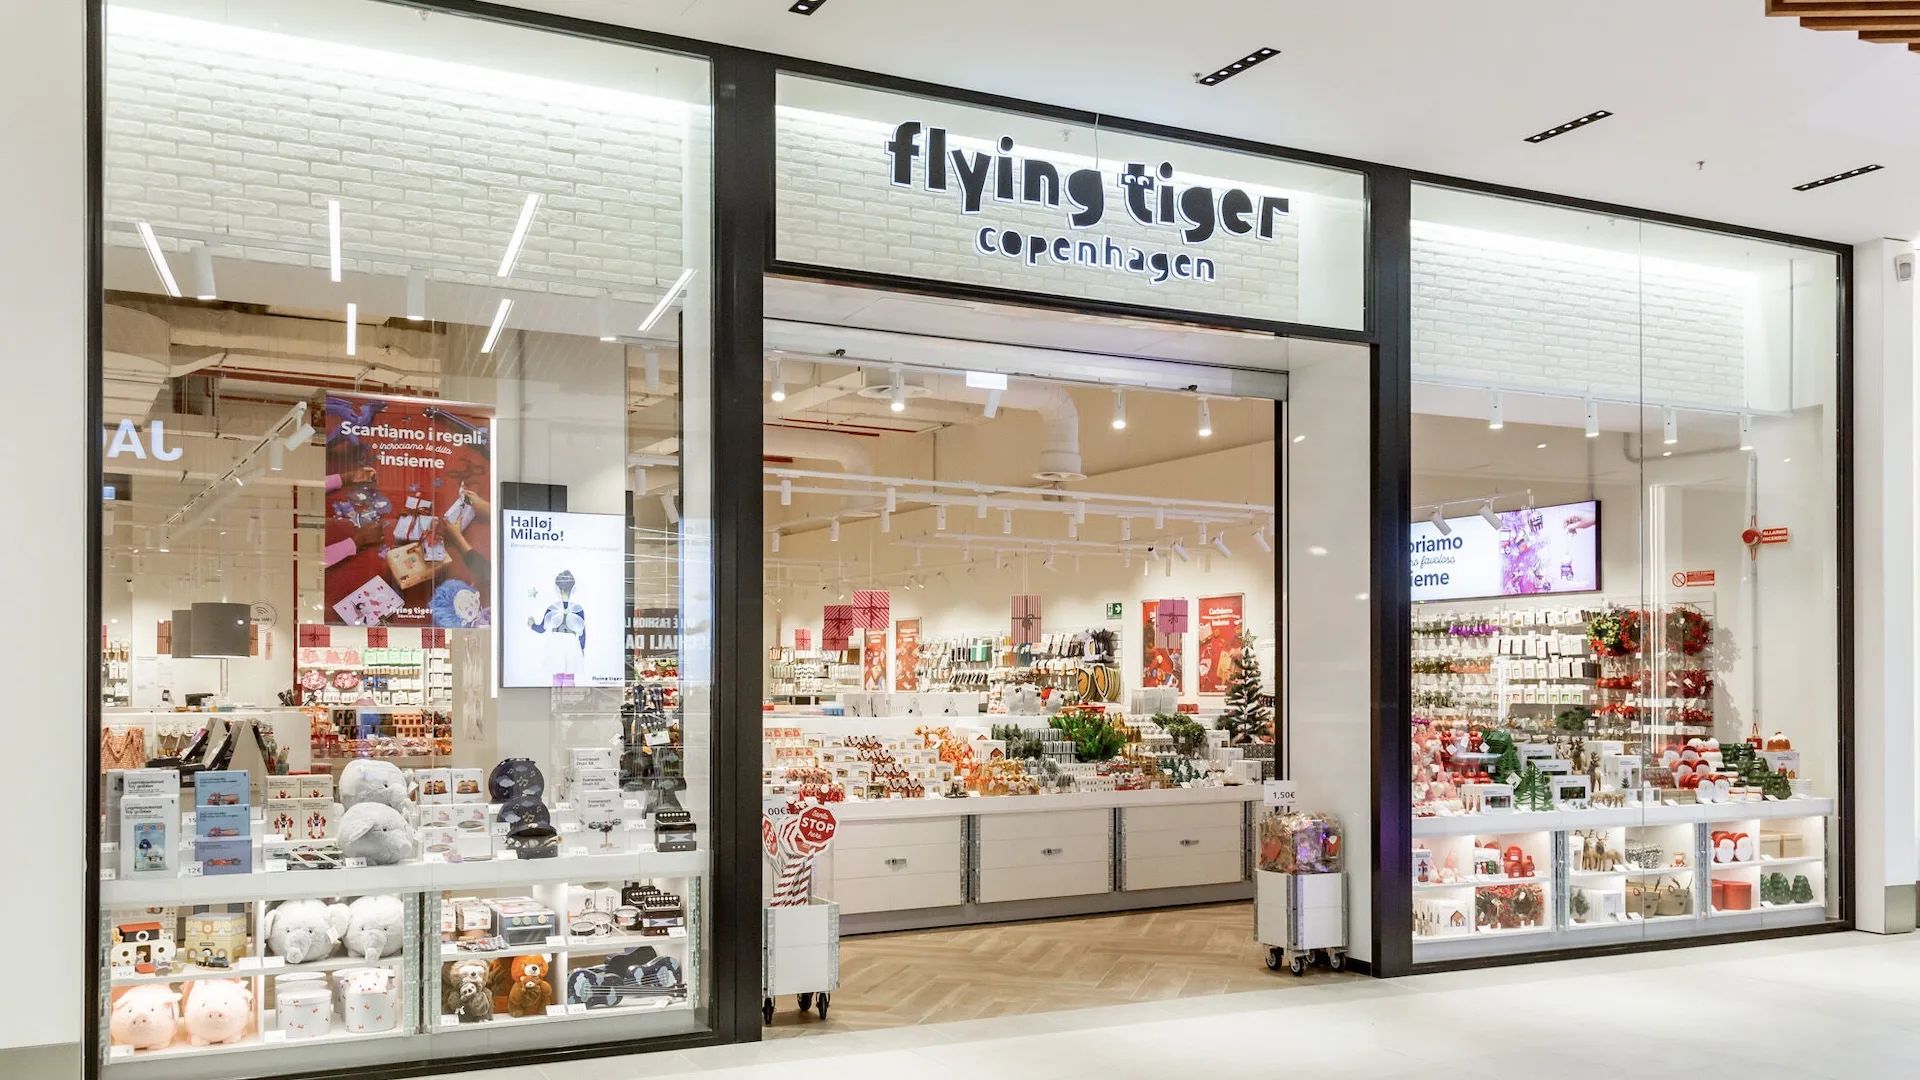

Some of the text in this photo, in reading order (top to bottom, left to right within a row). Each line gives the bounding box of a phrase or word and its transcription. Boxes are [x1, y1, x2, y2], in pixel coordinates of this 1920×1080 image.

[884, 120, 1290, 245] flying tiger
[975, 226, 1217, 285] copenhagen
[340, 420, 482, 446] Scartiamo i regali
[435, 444, 453, 455] dita
[380, 451, 445, 469] insieme
[510, 515, 552, 531] Halløj
[510, 528, 564, 541] Milano!
[1272, 791, 1296, 800] 1,50€
[801, 816, 835, 834] STOP
